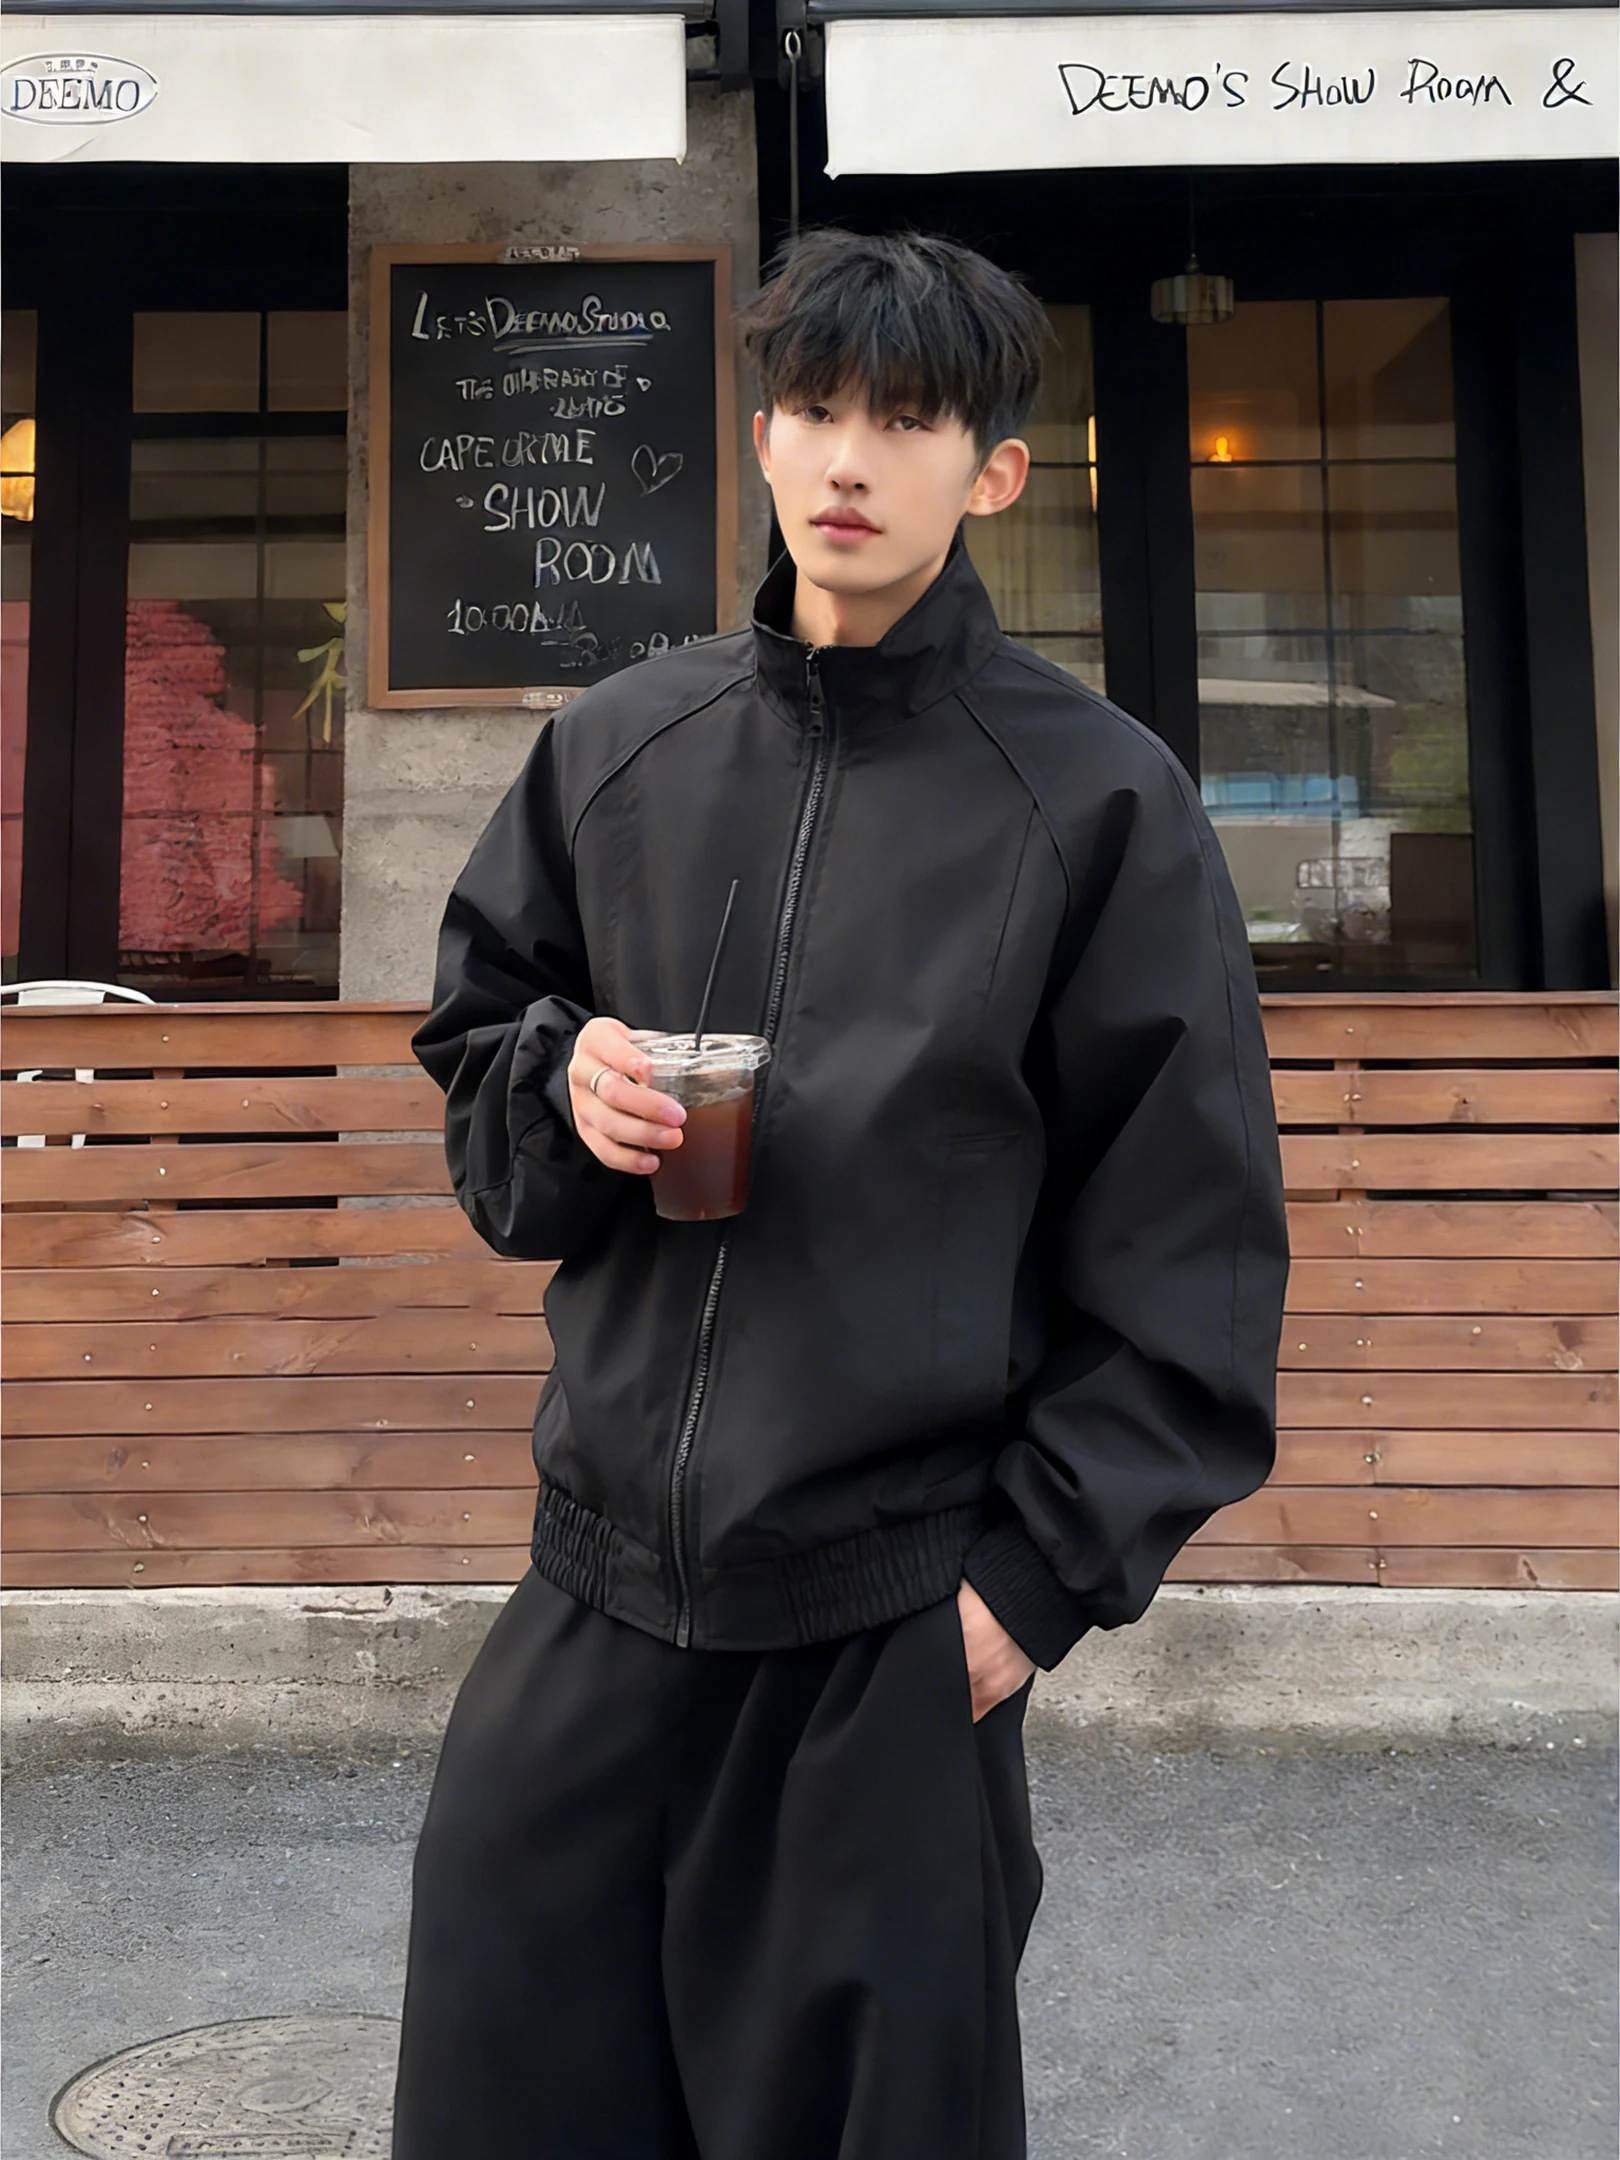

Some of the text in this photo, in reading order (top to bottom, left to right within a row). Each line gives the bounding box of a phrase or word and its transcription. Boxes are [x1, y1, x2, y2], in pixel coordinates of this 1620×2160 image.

[10, 77, 141, 112] DEEMO
[1057, 61, 1249, 116] DEEMO'S
[1541, 57, 1594, 109] &
[482, 481, 606, 532] SHOW
